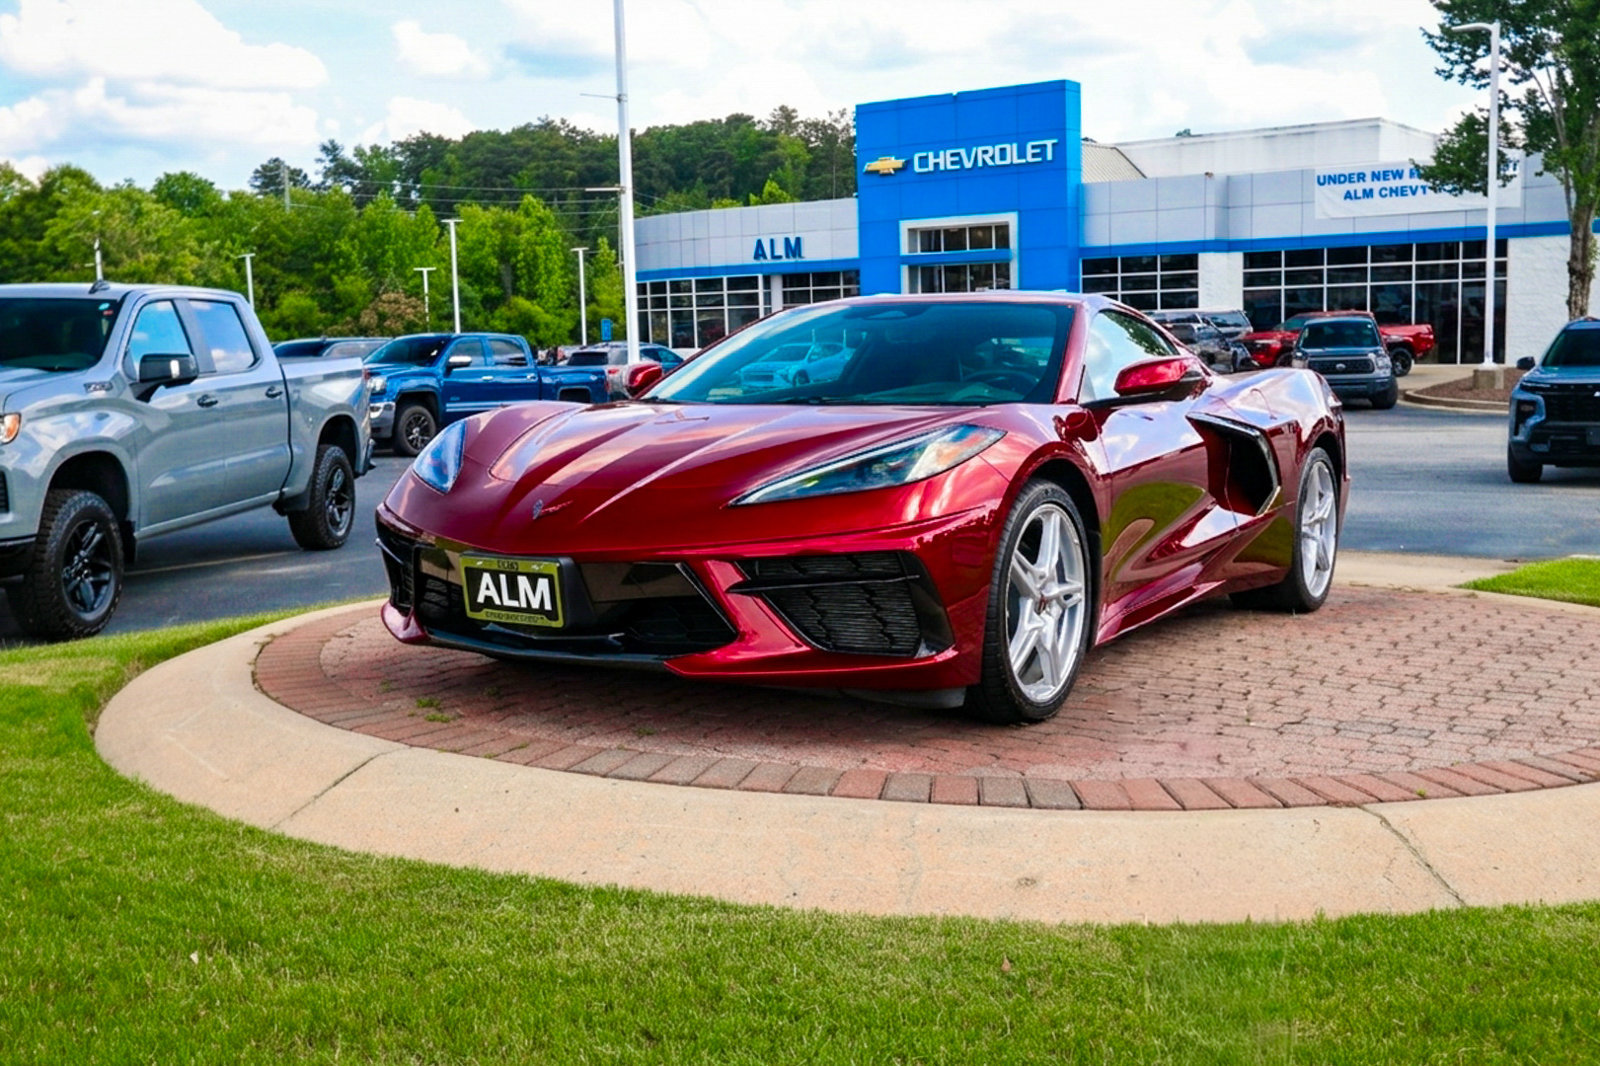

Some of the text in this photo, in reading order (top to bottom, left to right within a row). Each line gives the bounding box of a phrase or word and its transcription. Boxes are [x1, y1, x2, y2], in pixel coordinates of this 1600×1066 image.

[914, 139, 1058, 174] CHEVROLET
[1316, 172, 1367, 186] UNDER
[1371, 168, 1405, 182] NEW
[1343, 187, 1374, 201] ALM
[753, 236, 803, 260] ALM
[476, 572, 553, 611] ALM
